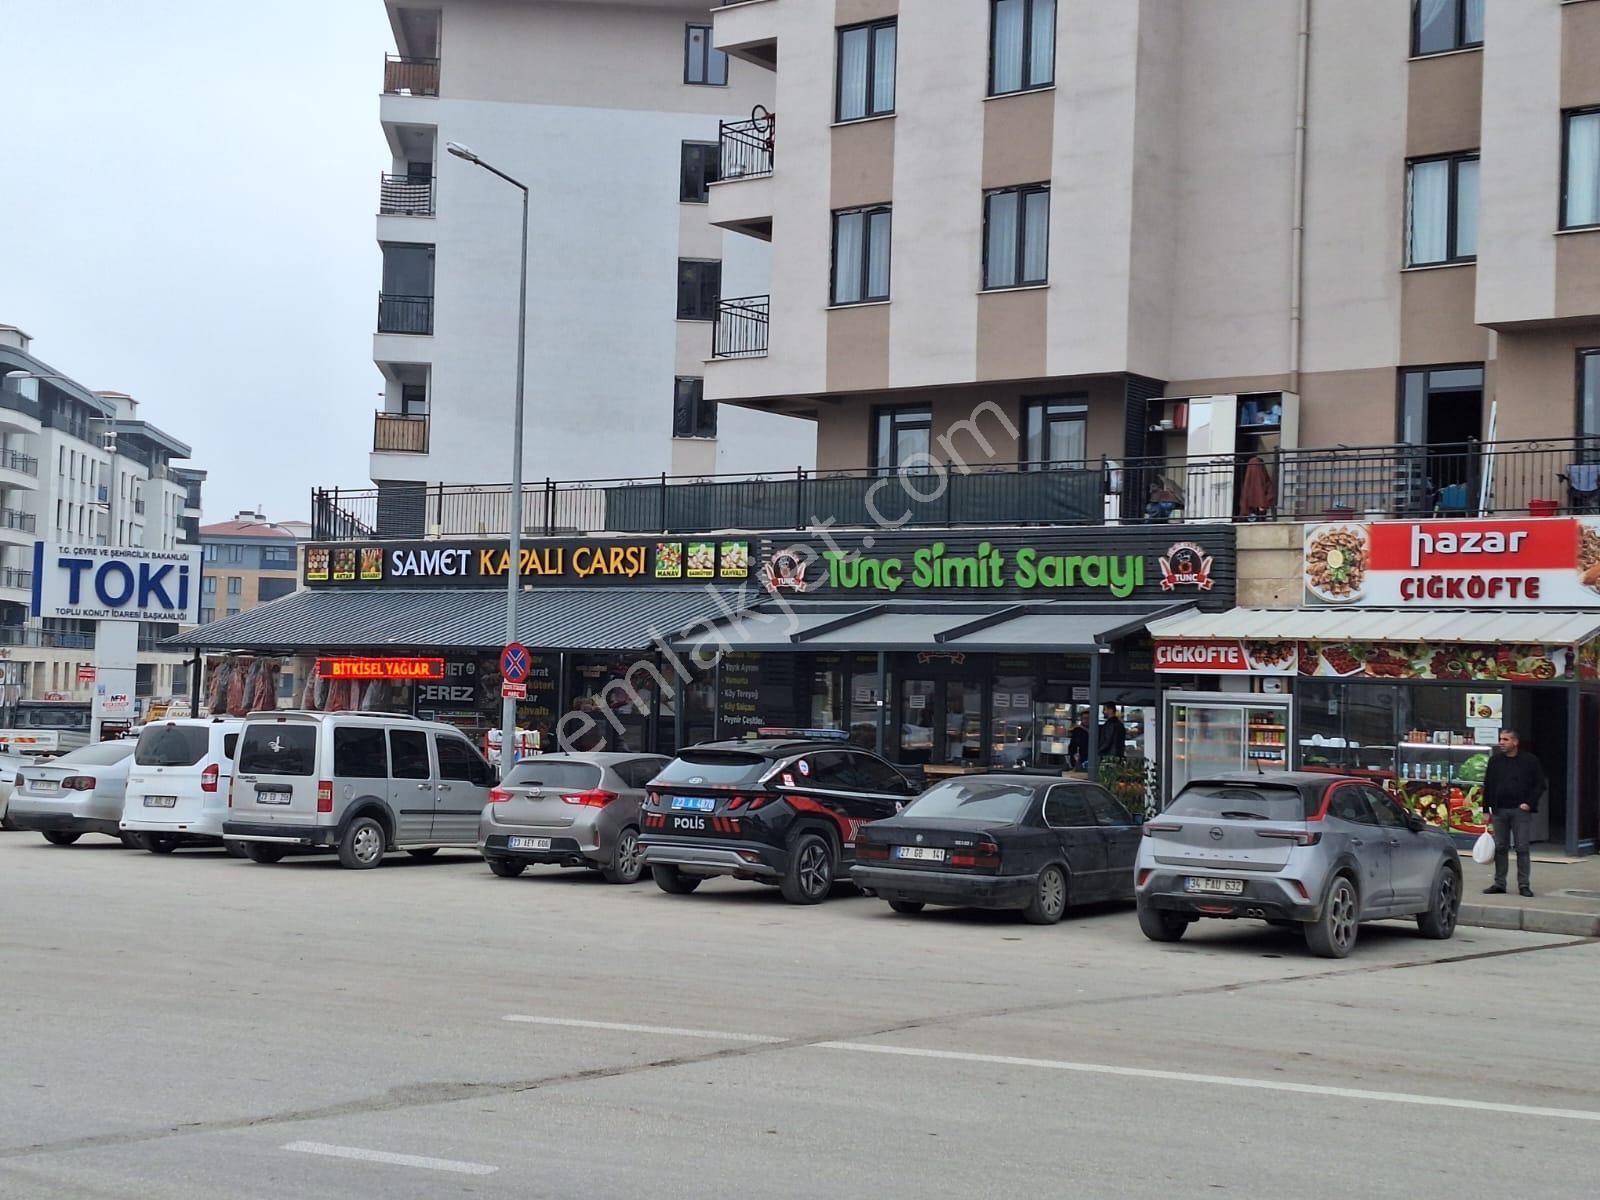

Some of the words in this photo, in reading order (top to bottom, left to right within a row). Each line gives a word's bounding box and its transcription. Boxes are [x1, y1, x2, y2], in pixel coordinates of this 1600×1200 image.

[1410, 524, 1529, 568] hazar
[73, 547, 97, 556] ÇEVRE
[152, 551, 189, 561] BAKANLIĞI
[391, 549, 472, 576] SAMET
[572, 546, 647, 578] ÇARŞI
[823, 549, 903, 593] Tunç
[913, 541, 1004, 590] Simit
[1015, 547, 1144, 598] Sarayı
[1399, 575, 1540, 602] ÇİĞKÖFTE
[55, 607, 81, 616] TOPLU
[83, 609, 110, 617] KONUT
[143, 610, 187, 621] BAŞKANLIĞI
[332, 661, 384, 675] BİTKİSEL
[386, 660, 430, 676] YAĞLAR
[674, 815, 705, 830] POLİS
[901, 847, 910, 857] 27
[1190, 879, 1201, 888] 34
[1205, 879, 1222, 889] FAU
